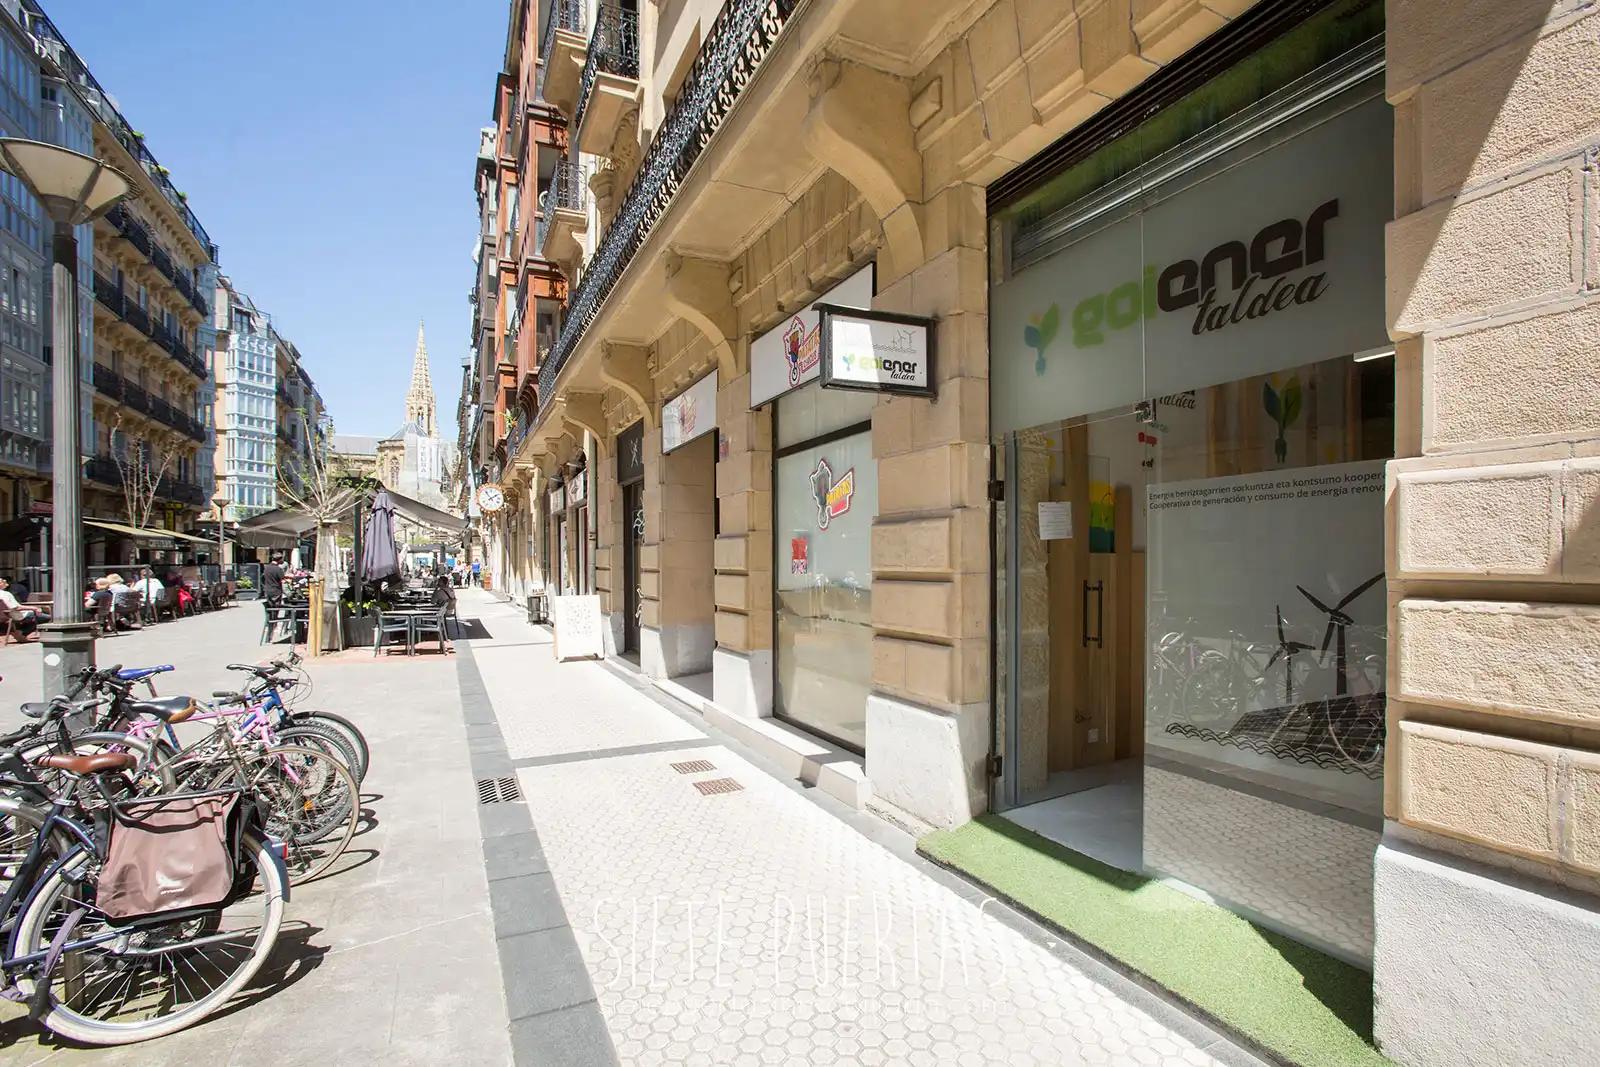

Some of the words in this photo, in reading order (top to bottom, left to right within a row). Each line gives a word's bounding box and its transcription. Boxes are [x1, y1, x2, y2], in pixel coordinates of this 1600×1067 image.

[1071, 197, 1340, 350] goiener
[1191, 270, 1330, 336] taldea
[1149, 498, 1190, 510] Cooperativa
[1192, 498, 1201, 506] de
[1202, 494, 1246, 507] generación
[1247, 494, 1253, 503] y
[1254, 490, 1294, 501] consumo
[1297, 489, 1309, 498] de
[1311, 486, 1349, 497] energía
[1175, 485, 1231, 498] berriztagarrien
[1232, 482, 1274, 493] sorkuntza
[1276, 481, 1290, 489] eta
[1293, 475, 1341, 487] kontsumo
